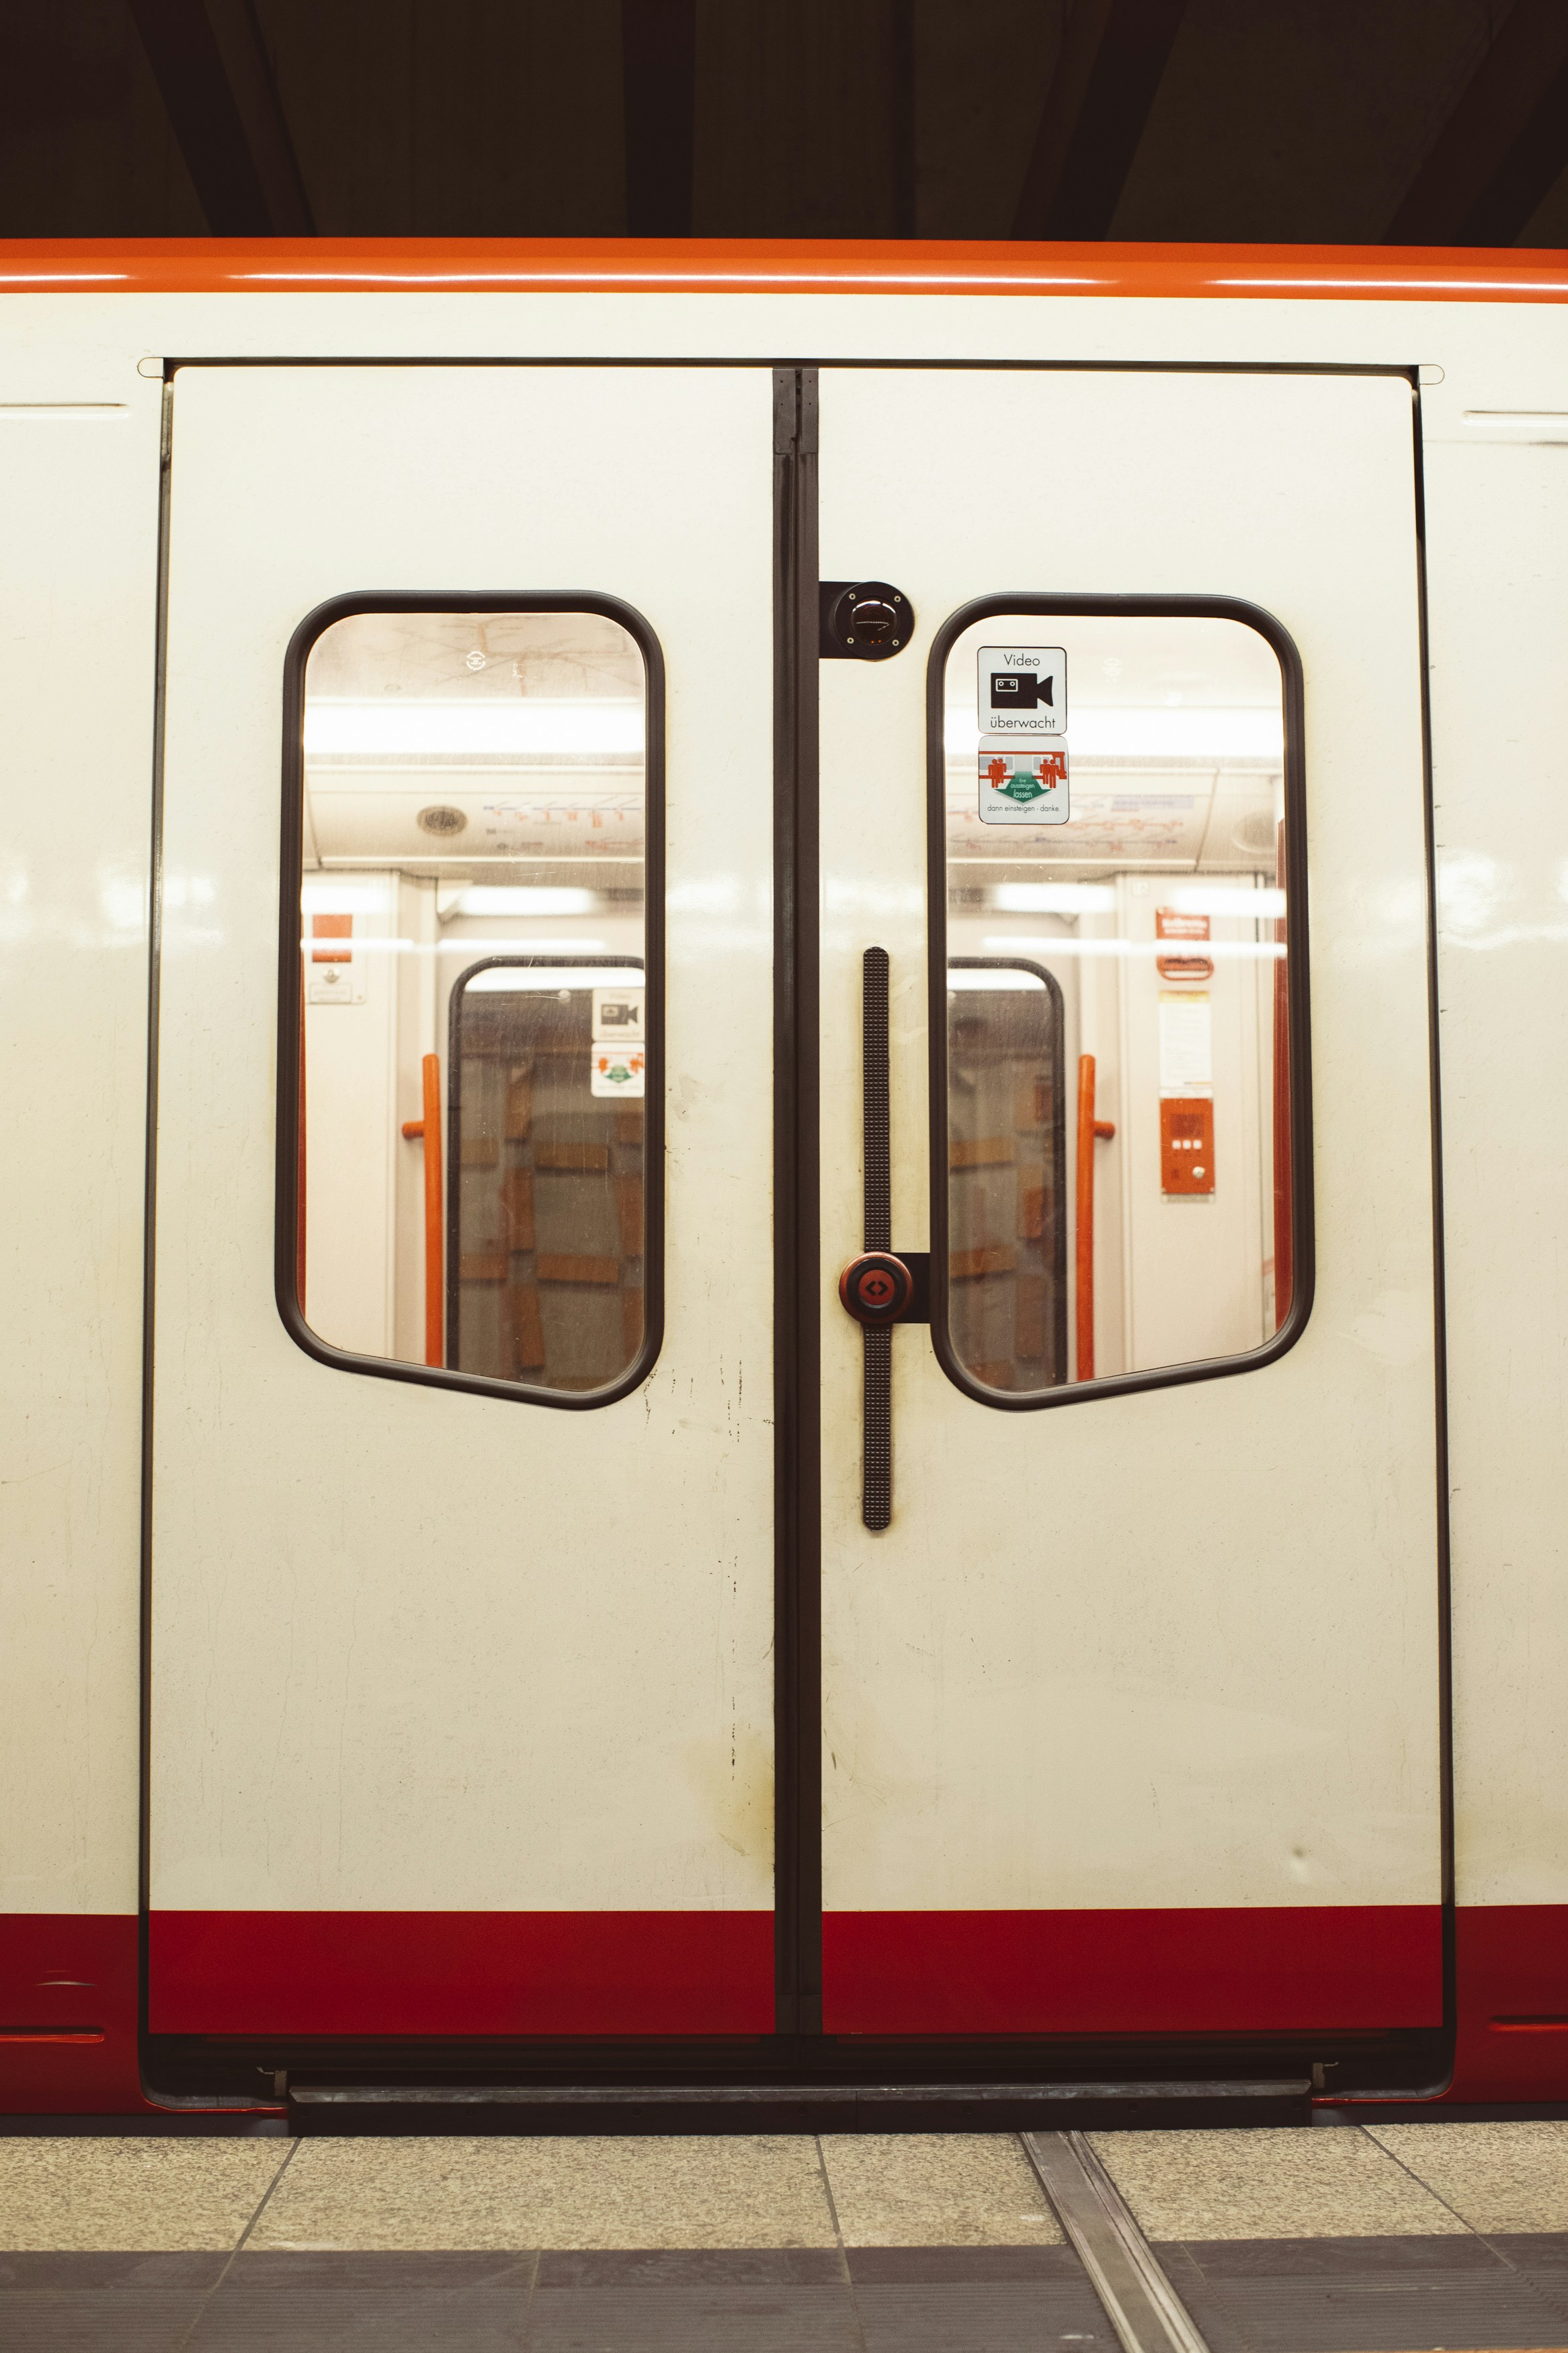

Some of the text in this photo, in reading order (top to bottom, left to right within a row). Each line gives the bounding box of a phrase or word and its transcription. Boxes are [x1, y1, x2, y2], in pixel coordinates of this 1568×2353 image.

[1003, 653, 1040, 666] Video
[990, 715, 1056, 728] überwacht
[1013, 789, 1033, 798] lassen
[1005, 805, 1035, 813] einsteigen
[1040, 804, 1061, 812] danke.
